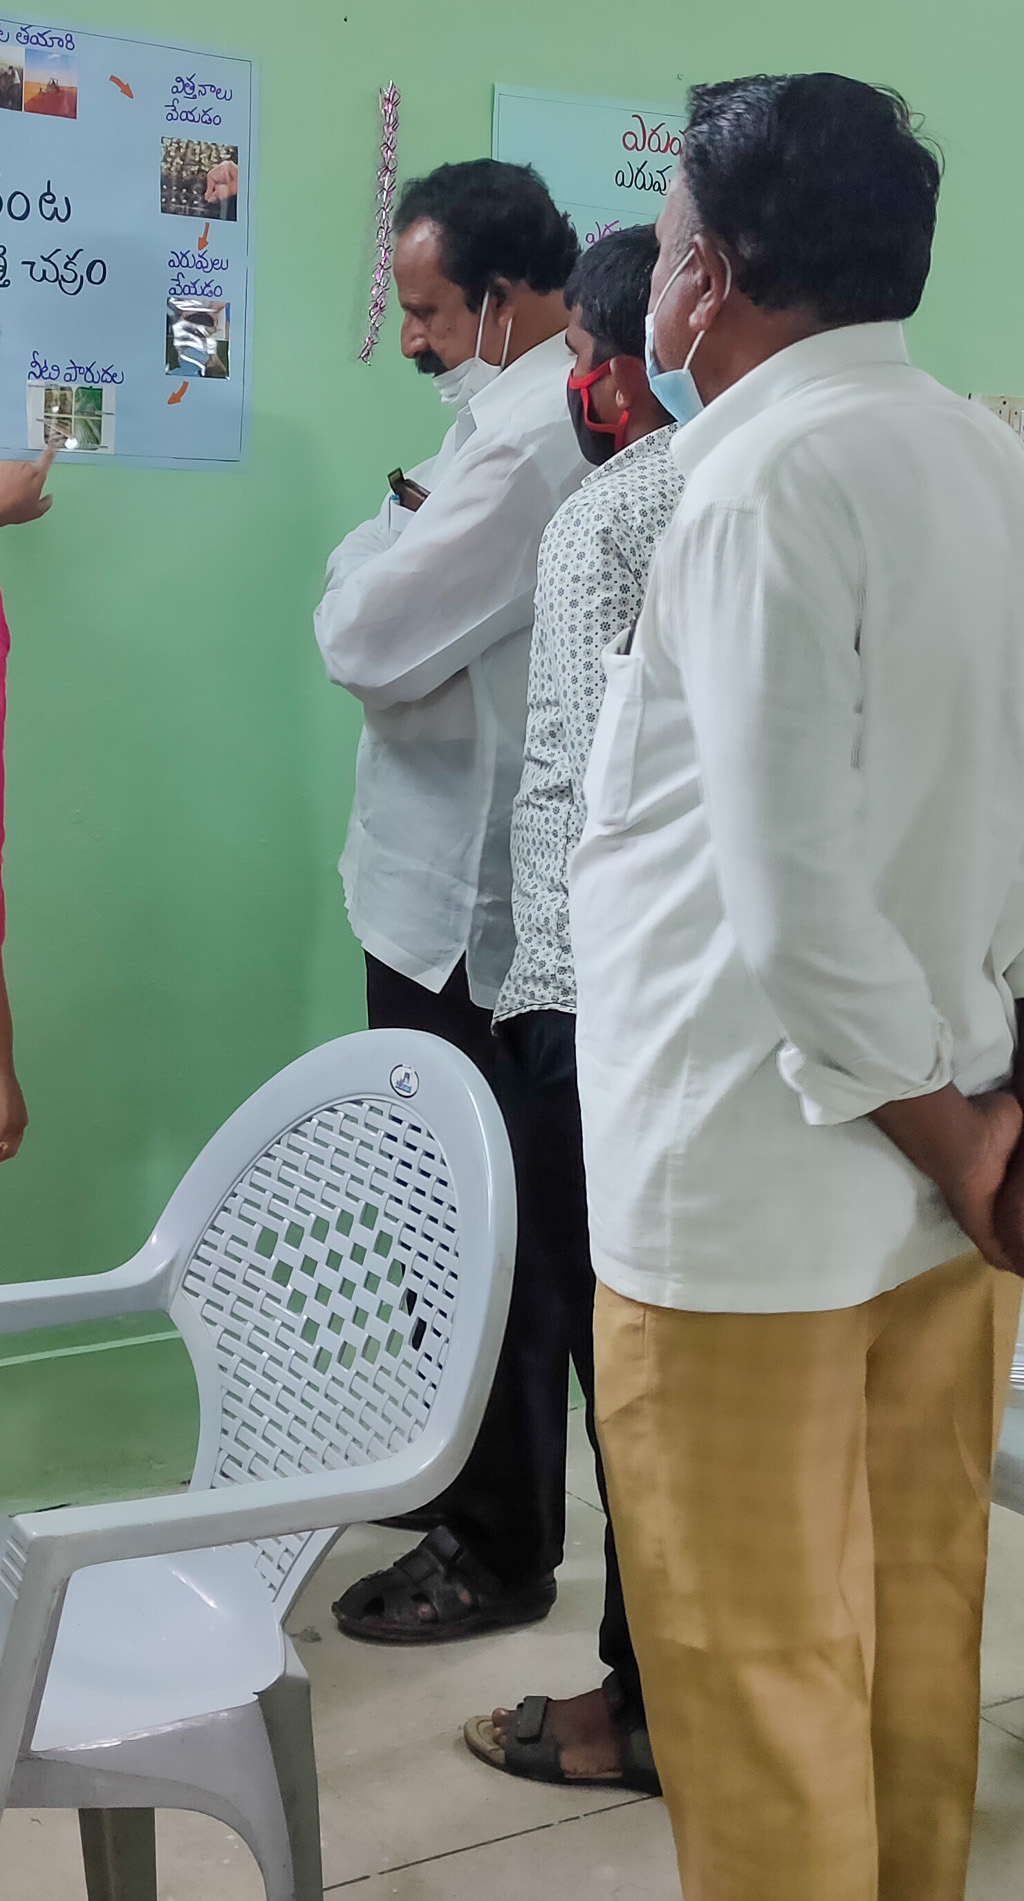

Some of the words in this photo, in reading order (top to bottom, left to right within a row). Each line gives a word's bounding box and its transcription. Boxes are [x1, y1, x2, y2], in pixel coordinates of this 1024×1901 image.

[16, 25, 75, 51] తయారి
[171, 73, 233, 101] విత్తనాలు
[164, 98, 222, 126] వేయడం
[21, 249, 107, 296] చక్రం
[168, 249, 229, 273] ఎరువులు
[168, 271, 223, 297] వేయడం
[27, 350, 61, 381] నీటి
[63, 359, 125, 385] పారుదల
